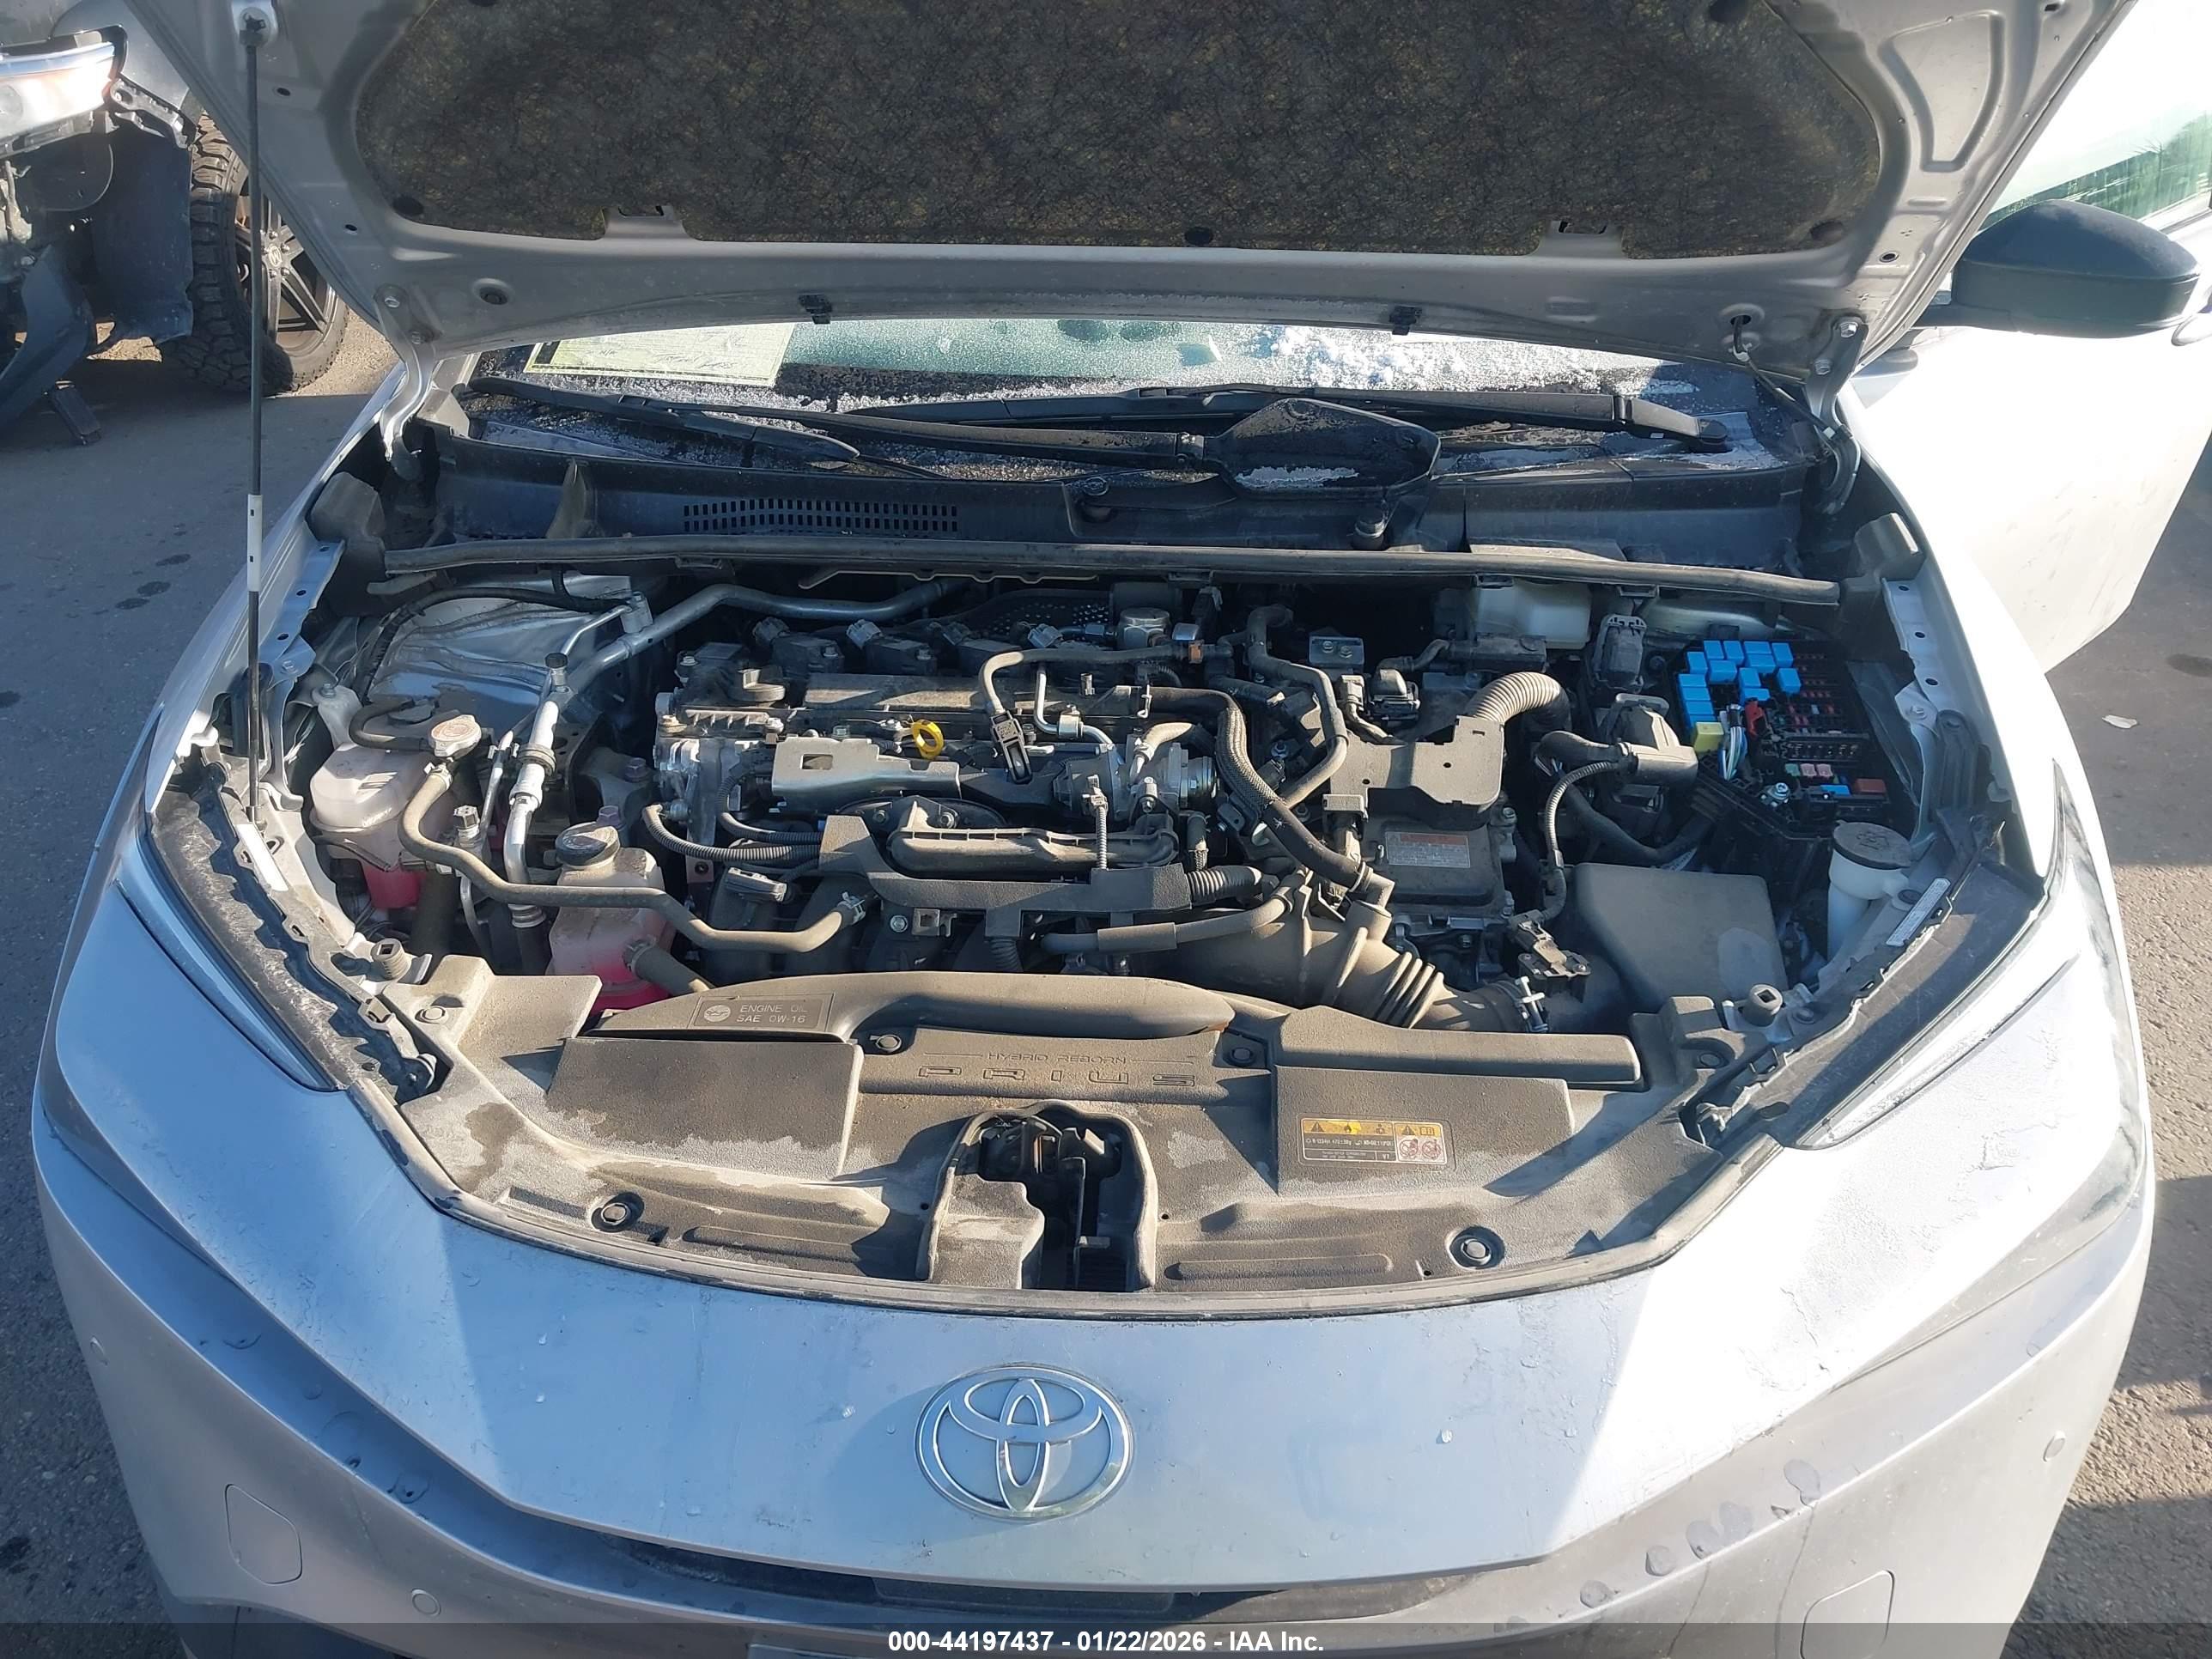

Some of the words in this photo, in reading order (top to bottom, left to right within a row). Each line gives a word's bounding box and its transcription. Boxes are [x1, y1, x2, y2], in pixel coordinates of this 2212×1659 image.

[739, 1004, 783, 1013] ENGINE
[790, 1004, 809, 1013] OIL
[736, 1014, 763, 1024] SAE
[769, 1014, 806, 1024] 0W-16
[988, 1052, 1048, 1062] HYBRID
[1056, 1054, 1127, 1065] REBORN
[918, 1065, 1196, 1087] PRIUS
